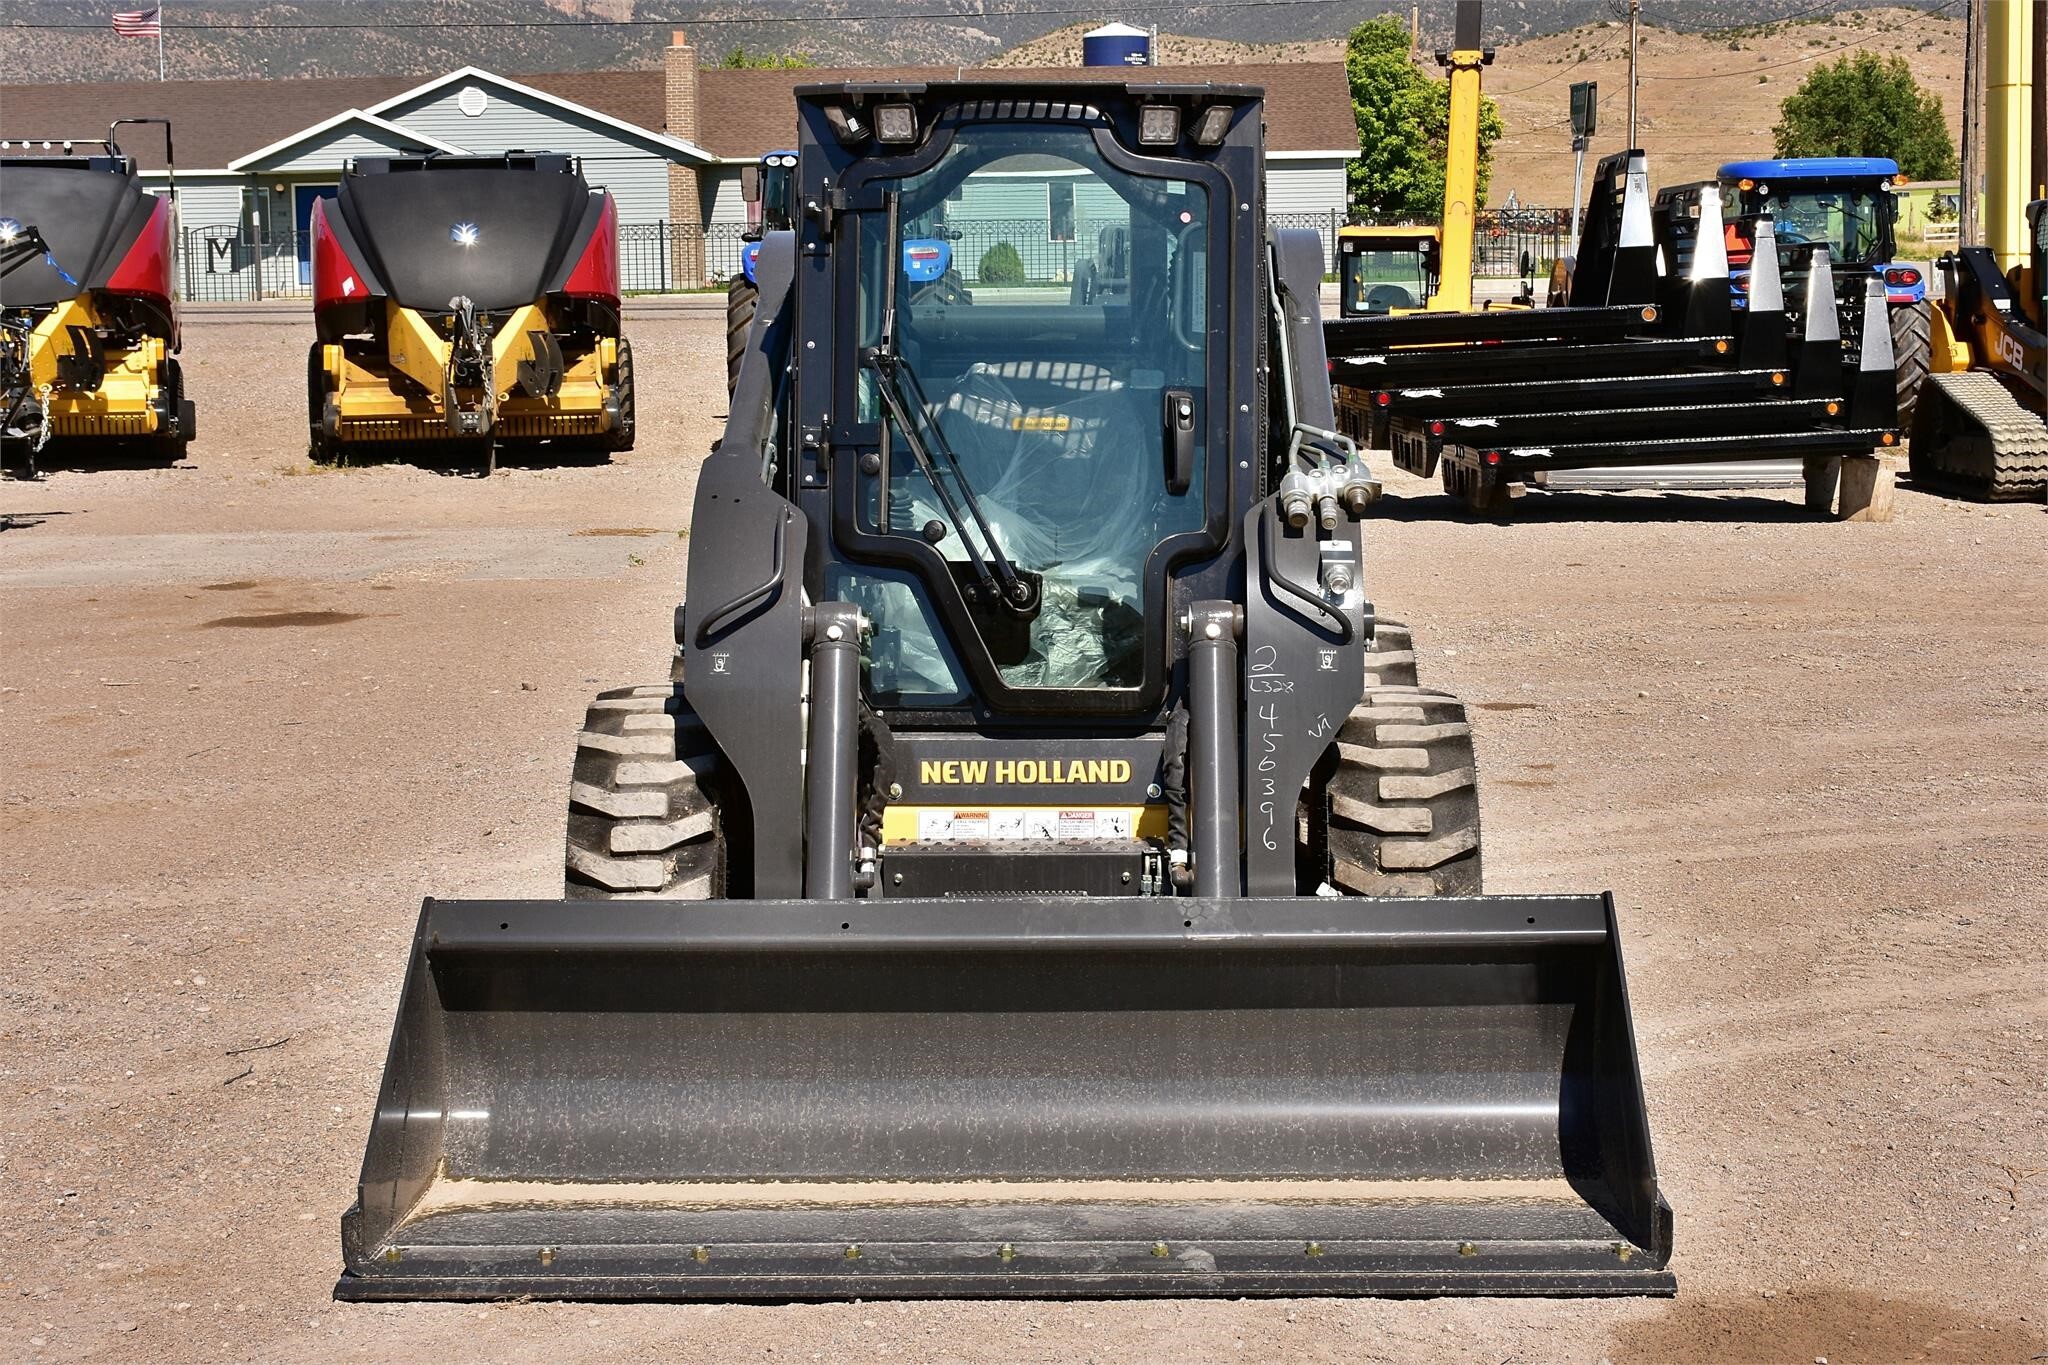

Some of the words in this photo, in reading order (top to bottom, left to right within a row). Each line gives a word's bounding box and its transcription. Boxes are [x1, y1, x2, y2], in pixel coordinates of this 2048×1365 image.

[1994, 330, 2024, 371] JCB
[1251, 645, 1277, 672] 2
[921, 760, 989, 784] NEW
[995, 760, 1131, 784] HOLLAND
[1066, 811, 1094, 819] DANGER
